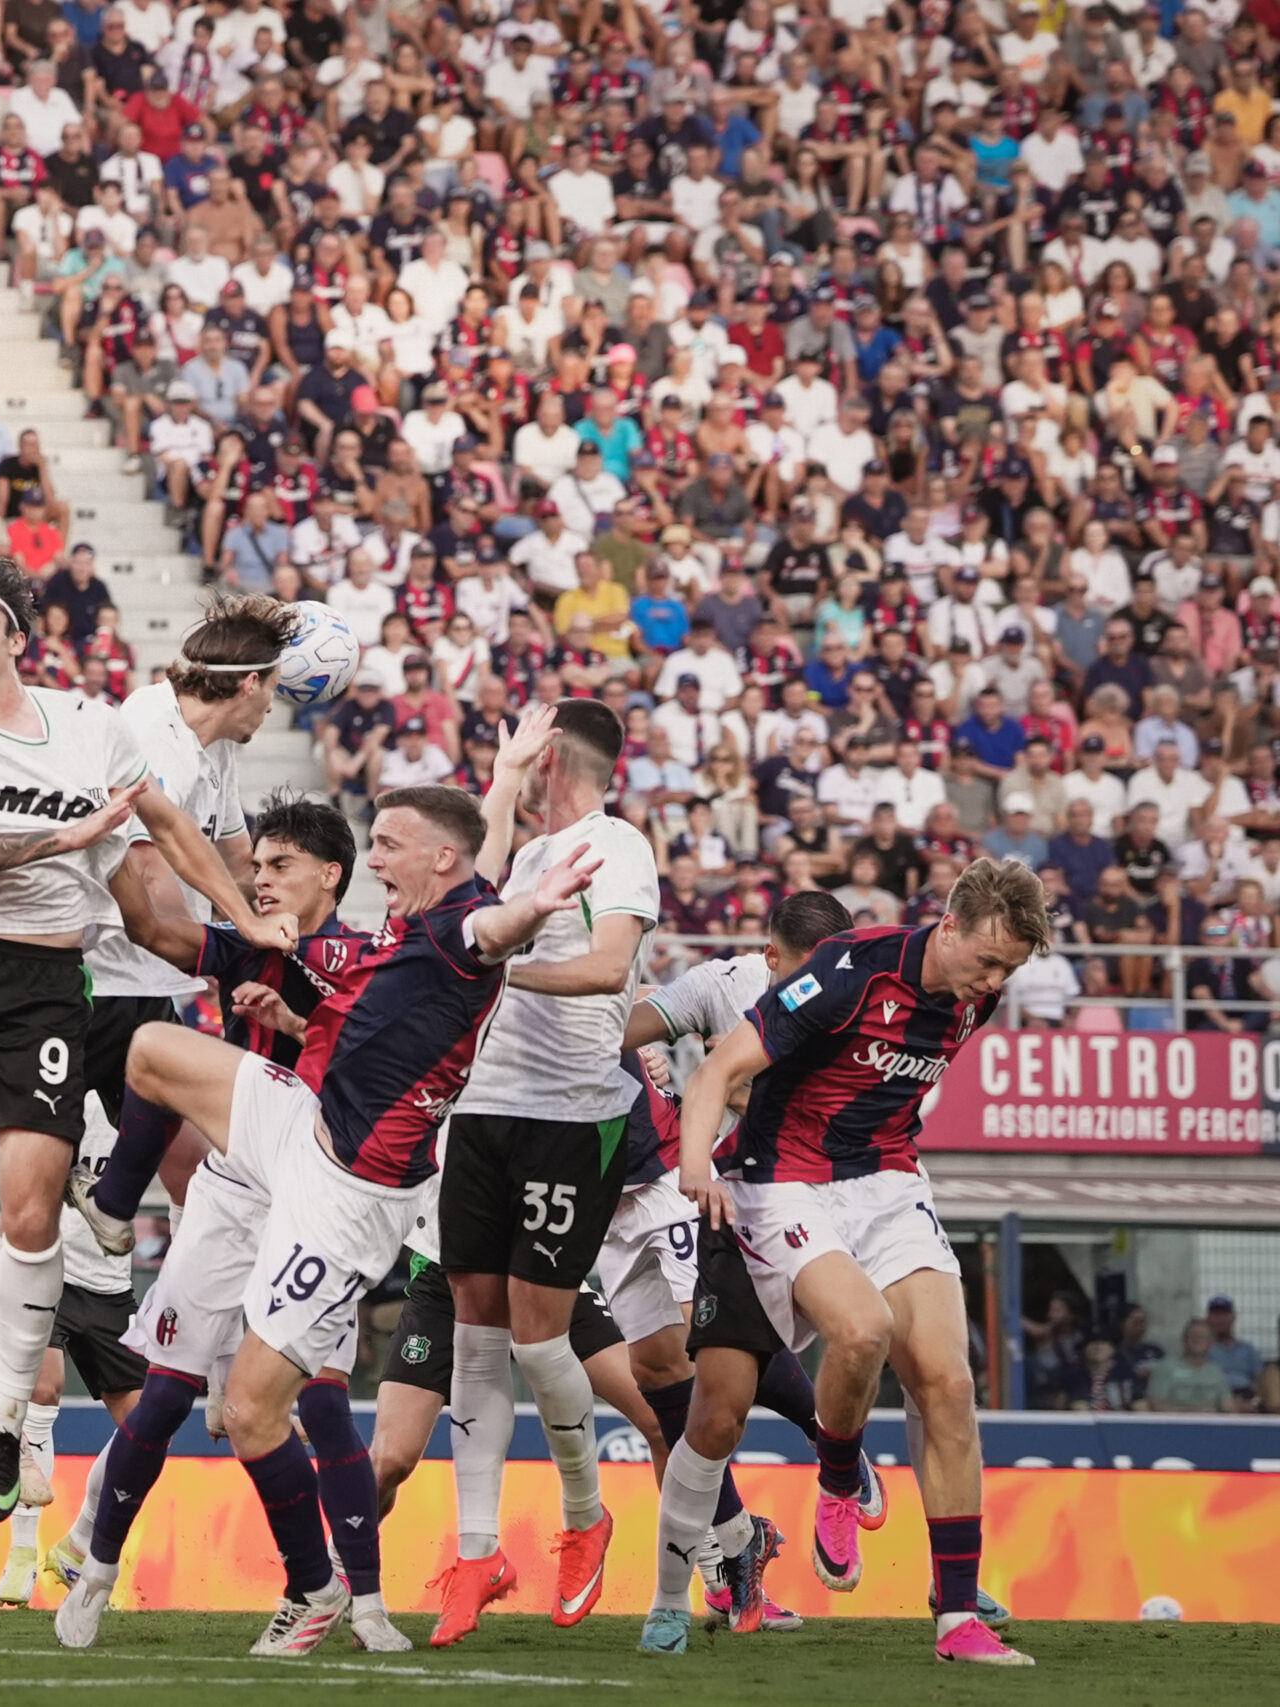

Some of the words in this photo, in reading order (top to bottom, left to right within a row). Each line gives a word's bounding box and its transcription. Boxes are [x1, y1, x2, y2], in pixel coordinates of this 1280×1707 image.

[38, 1037, 69, 1085] 9
[980, 1034, 1196, 1100] CENTRO
[983, 1103, 1167, 1141] ASSOCIAZIONE
[1179, 1106, 1280, 1143] PERCOR
[522, 1181, 577, 1235] 35
[270, 1242, 327, 1302] 19
